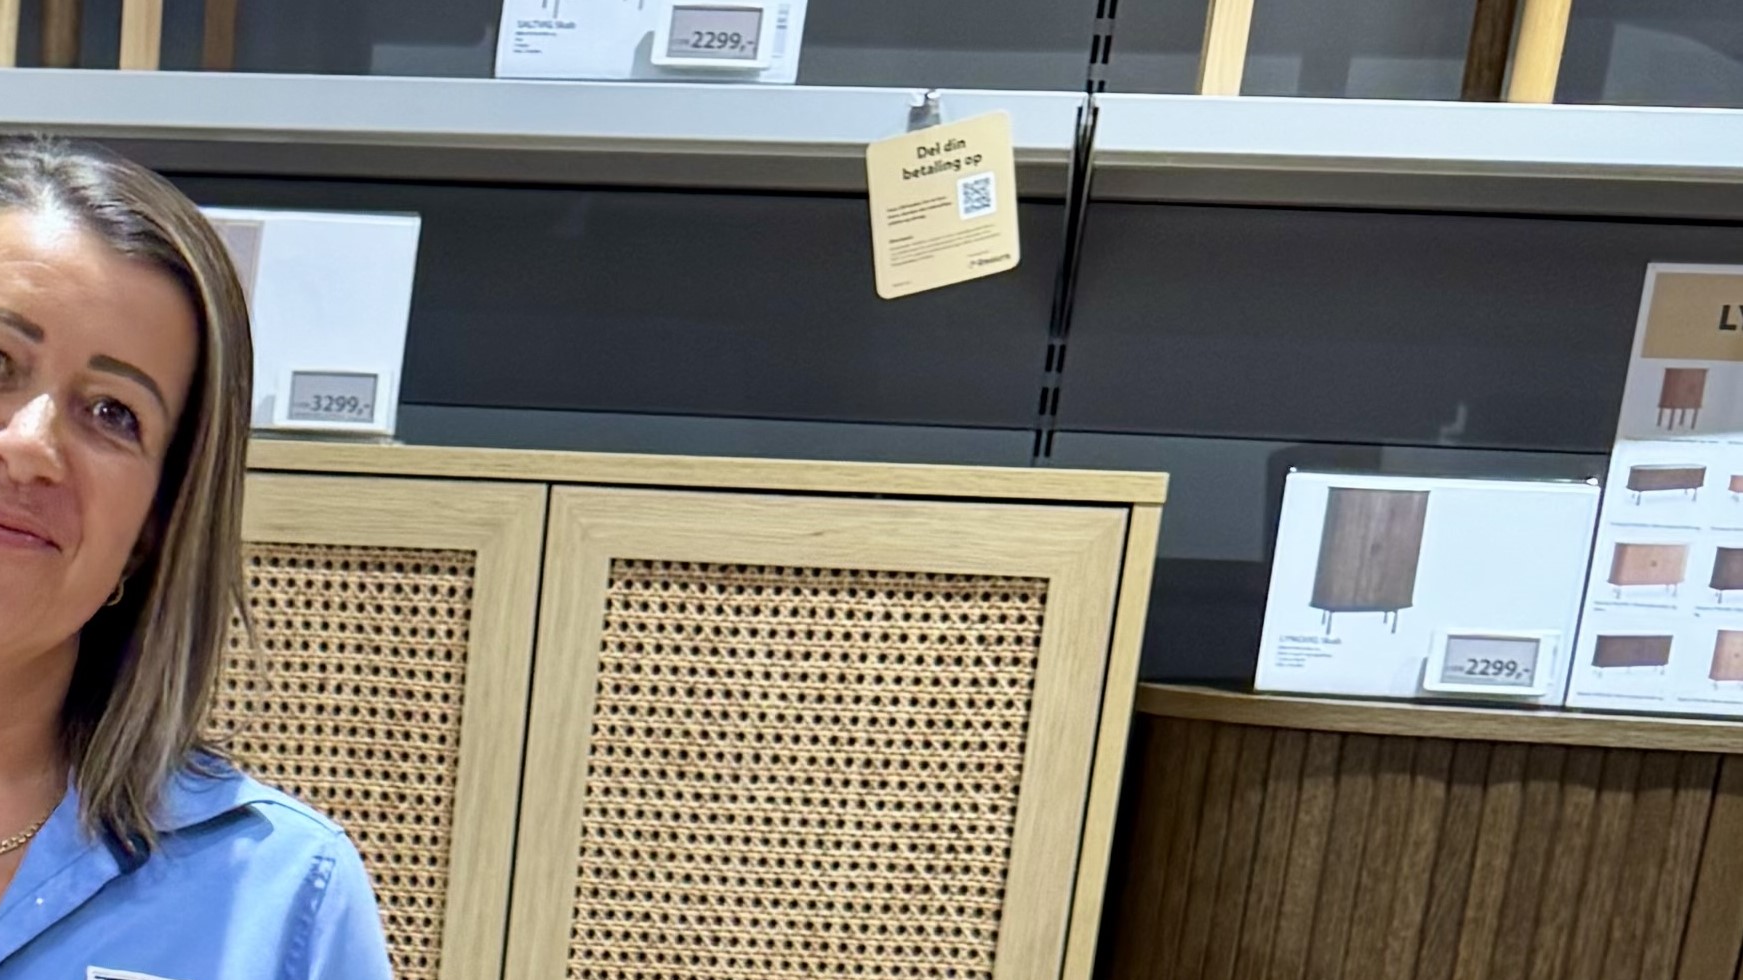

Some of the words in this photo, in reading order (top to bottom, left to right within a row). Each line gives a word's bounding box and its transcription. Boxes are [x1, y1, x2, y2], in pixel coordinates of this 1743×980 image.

[690, 30, 755, 52] 2299,-
[916, 142, 941, 159] Del
[943, 138, 967, 152] din
[902, 157, 962, 180] betaling
[964, 153, 983, 167] op
[311, 394, 371, 416] 3299,-
[1464, 657, 1532, 680] 2299,-
